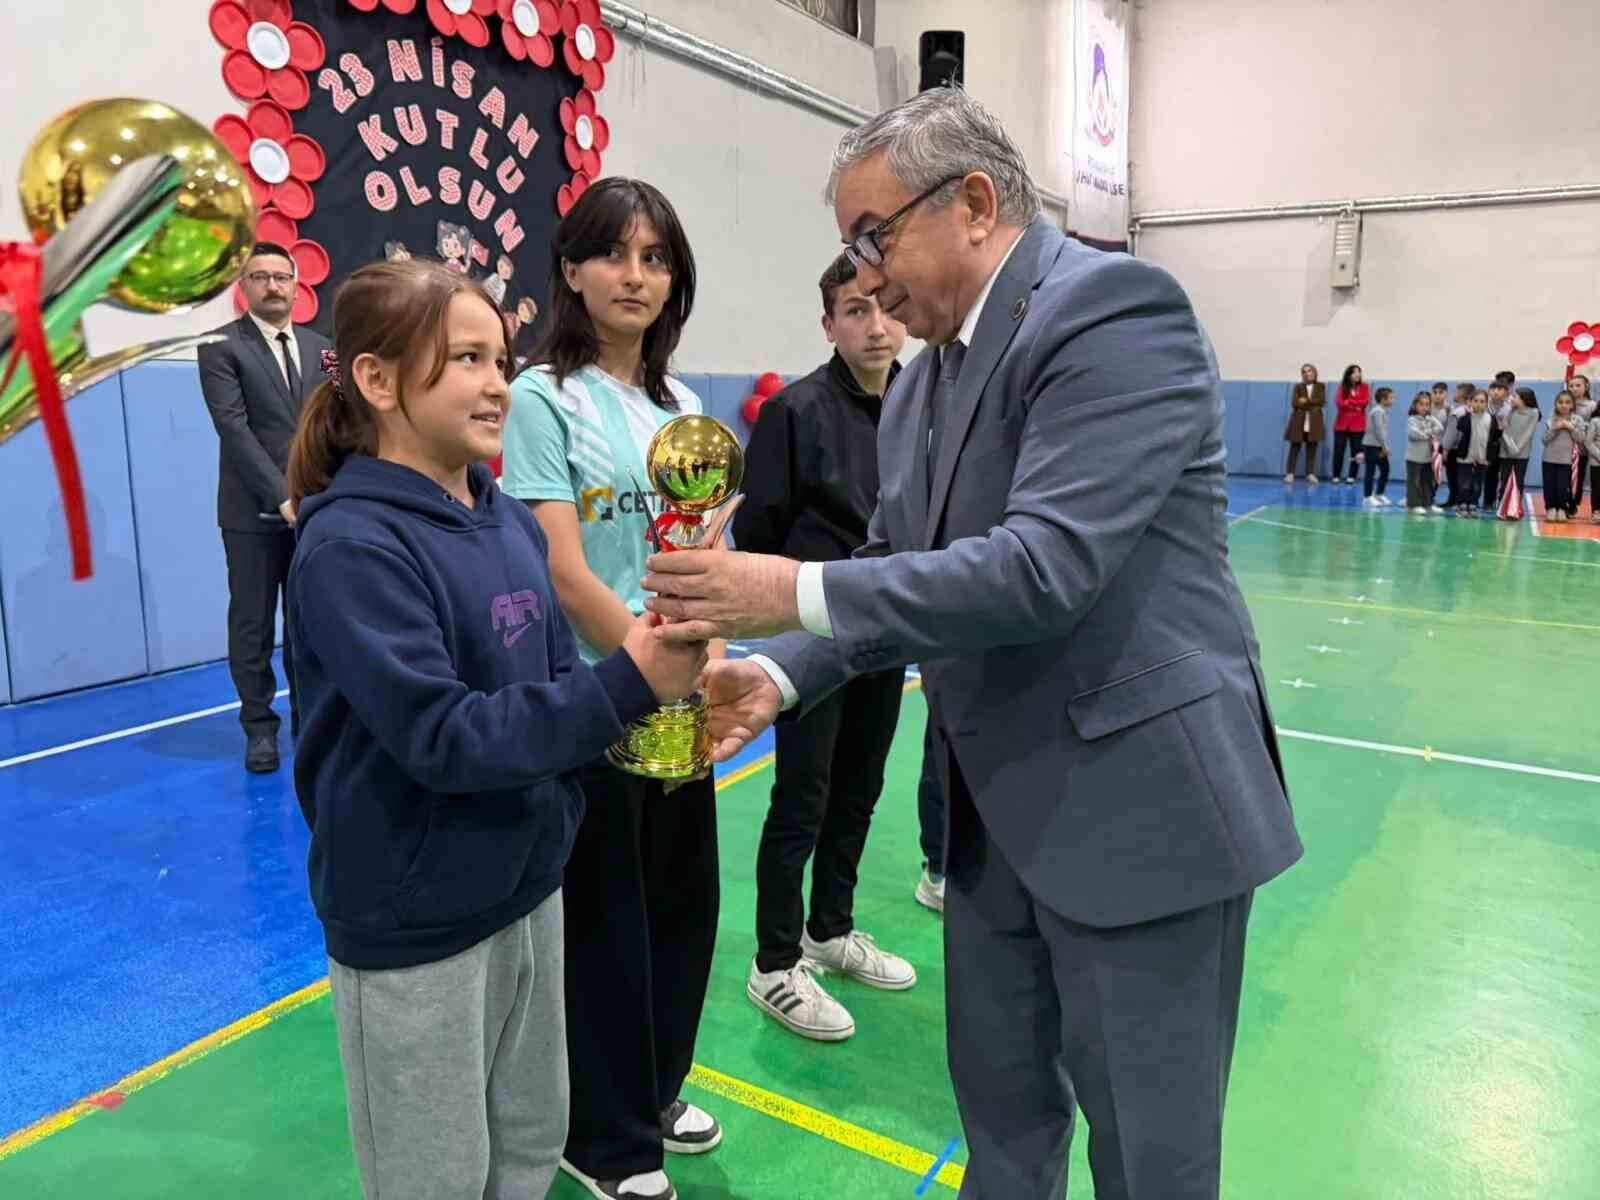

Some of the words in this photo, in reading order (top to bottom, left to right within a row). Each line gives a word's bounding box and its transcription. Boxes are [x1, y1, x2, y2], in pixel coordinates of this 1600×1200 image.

[318, 52, 375, 114] 23
[357, 104, 526, 194] KUTLU
[364, 166, 526, 253] OLSUN
